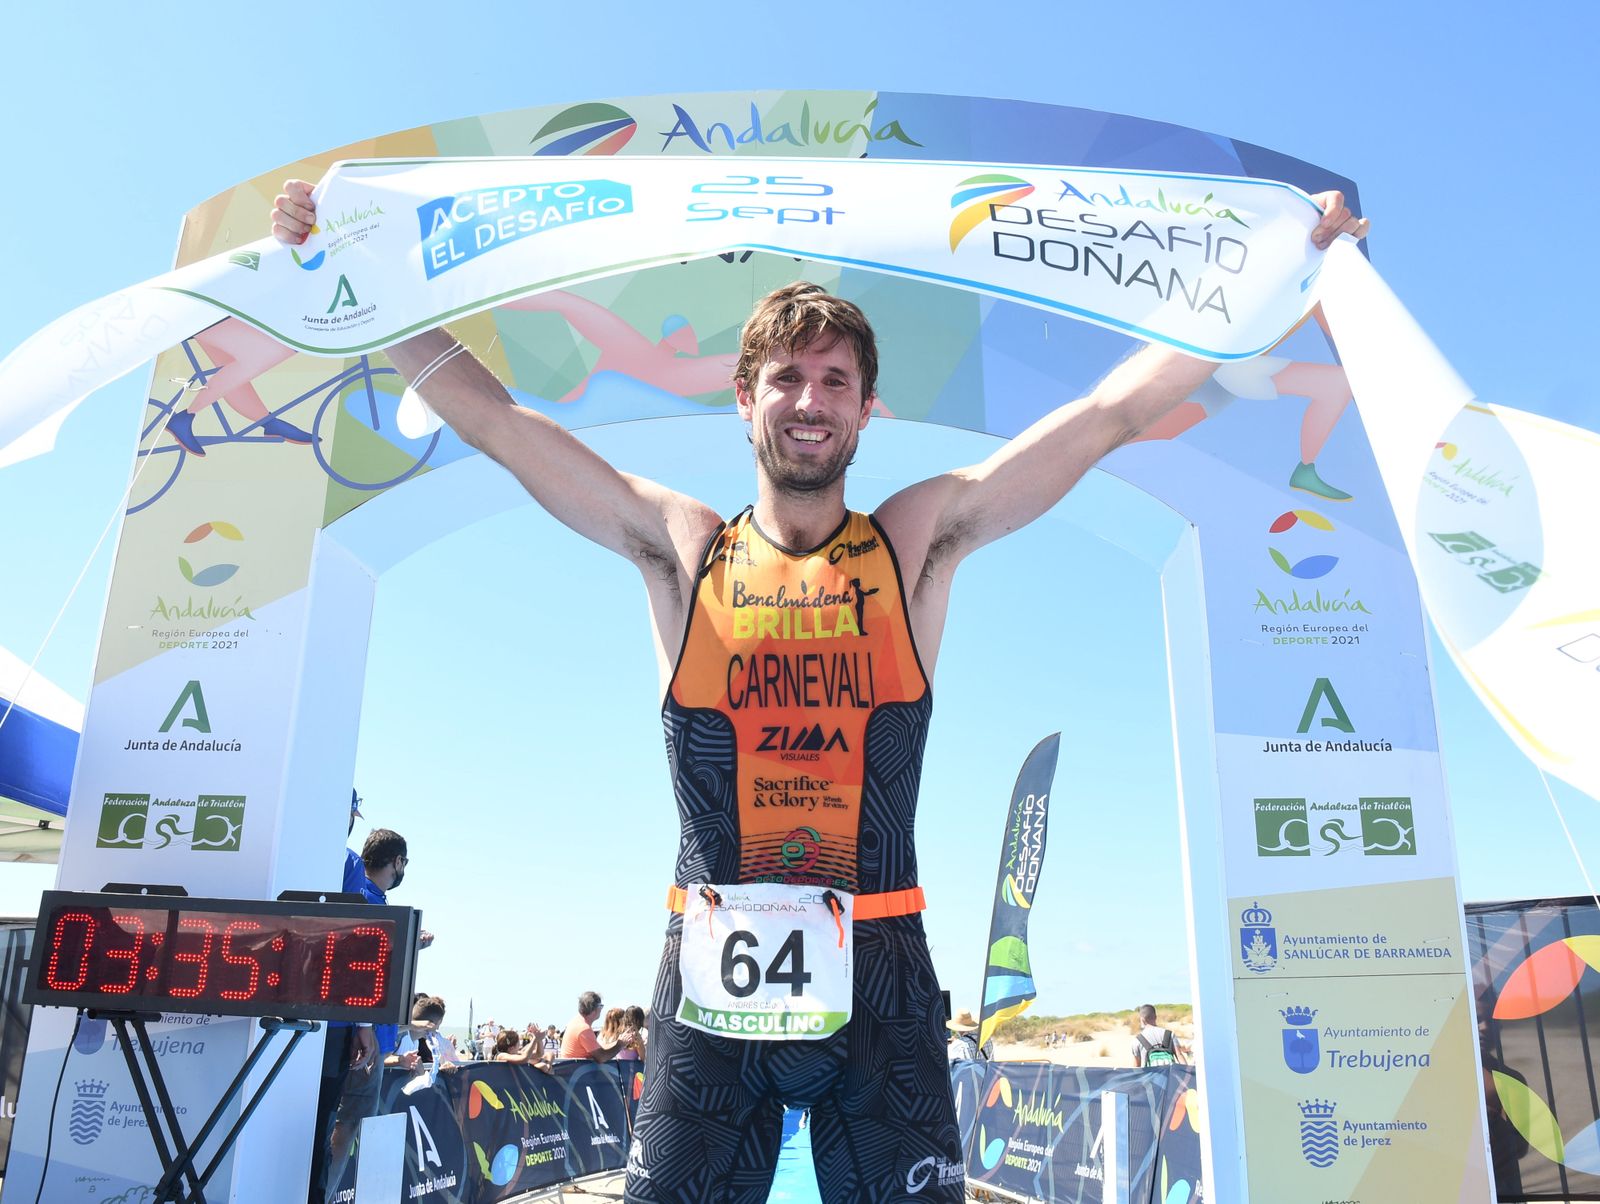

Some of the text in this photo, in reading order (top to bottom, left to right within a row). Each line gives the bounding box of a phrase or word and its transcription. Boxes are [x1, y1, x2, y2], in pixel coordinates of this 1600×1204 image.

[658, 99, 925, 153] Andalucía
[691, 175, 834, 197] 25
[428, 183, 586, 240] ACEPTO
[686, 202, 845, 225] Sept
[1058, 179, 1251, 229] Andalucía
[430, 195, 626, 270] EL DESAFÍO
[989, 203, 1248, 274] DESAFÍO
[993, 231, 1231, 324] DOÑANA
[302, 303, 377, 324] Junta de Andalucía
[151, 595, 256, 621] Andalucía
[1253, 588, 1373, 615] Andalucía
[732, 605, 860, 640] BRILLA
[1261, 624, 1369, 634] Región Europea del
[151, 629, 249, 640] Región Europea del
[1273, 636, 1360, 645] DEPORTE 2021
[159, 640, 238, 649] DEPORTE 2021
[727, 652, 876, 710] CARNEVALI
[124, 738, 242, 752] Junta de Andalucía
[1263, 738, 1393, 753] Junta de Andalucía
[780, 753, 820, 761] VISUALES
[754, 776, 829, 792] Sacrifice
[104, 796, 148, 806] Federación
[152, 798, 196, 807] Andaluza
[198, 798, 208, 807] de
[754, 792, 819, 811] & Glory
[1255, 802, 1305, 811] Federación
[1310, 802, 1358, 811] Andaluza
[1361, 802, 1371, 810] de
[1025, 794, 1048, 893] DOÑANA
[1283, 933, 1387, 950] Ayuntamiento de
[1284, 946, 1452, 960] SANLÚCAR DE BARRAMEDA
[721, 930, 811, 998] 64
[196, 1013, 210, 1026] de
[699, 1010, 825, 1032] MASCULINO
[1324, 1025, 1430, 1041] Ayuntamiento de
[1326, 1049, 1430, 1071] Trebujena
[108, 1115, 120, 1126] de
[1012, 1088, 1064, 1134] Andalucía
[1343, 1120, 1428, 1134] Ayuntamiento
[521, 1135, 540, 1150] Región
[540, 1132, 561, 1145] Europea
[1024, 1139, 1044, 1156] Europea
[1344, 1135, 1392, 1148] de Jerez
[525, 1146, 567, 1167] DEPORTE 2021
[1004, 1154, 1042, 1173] DEPORTE 2021
[1075, 1163, 1090, 1178] Junta
[409, 1170, 457, 1199] Junta de Andalucía
[333, 1187, 355, 1204] urope
